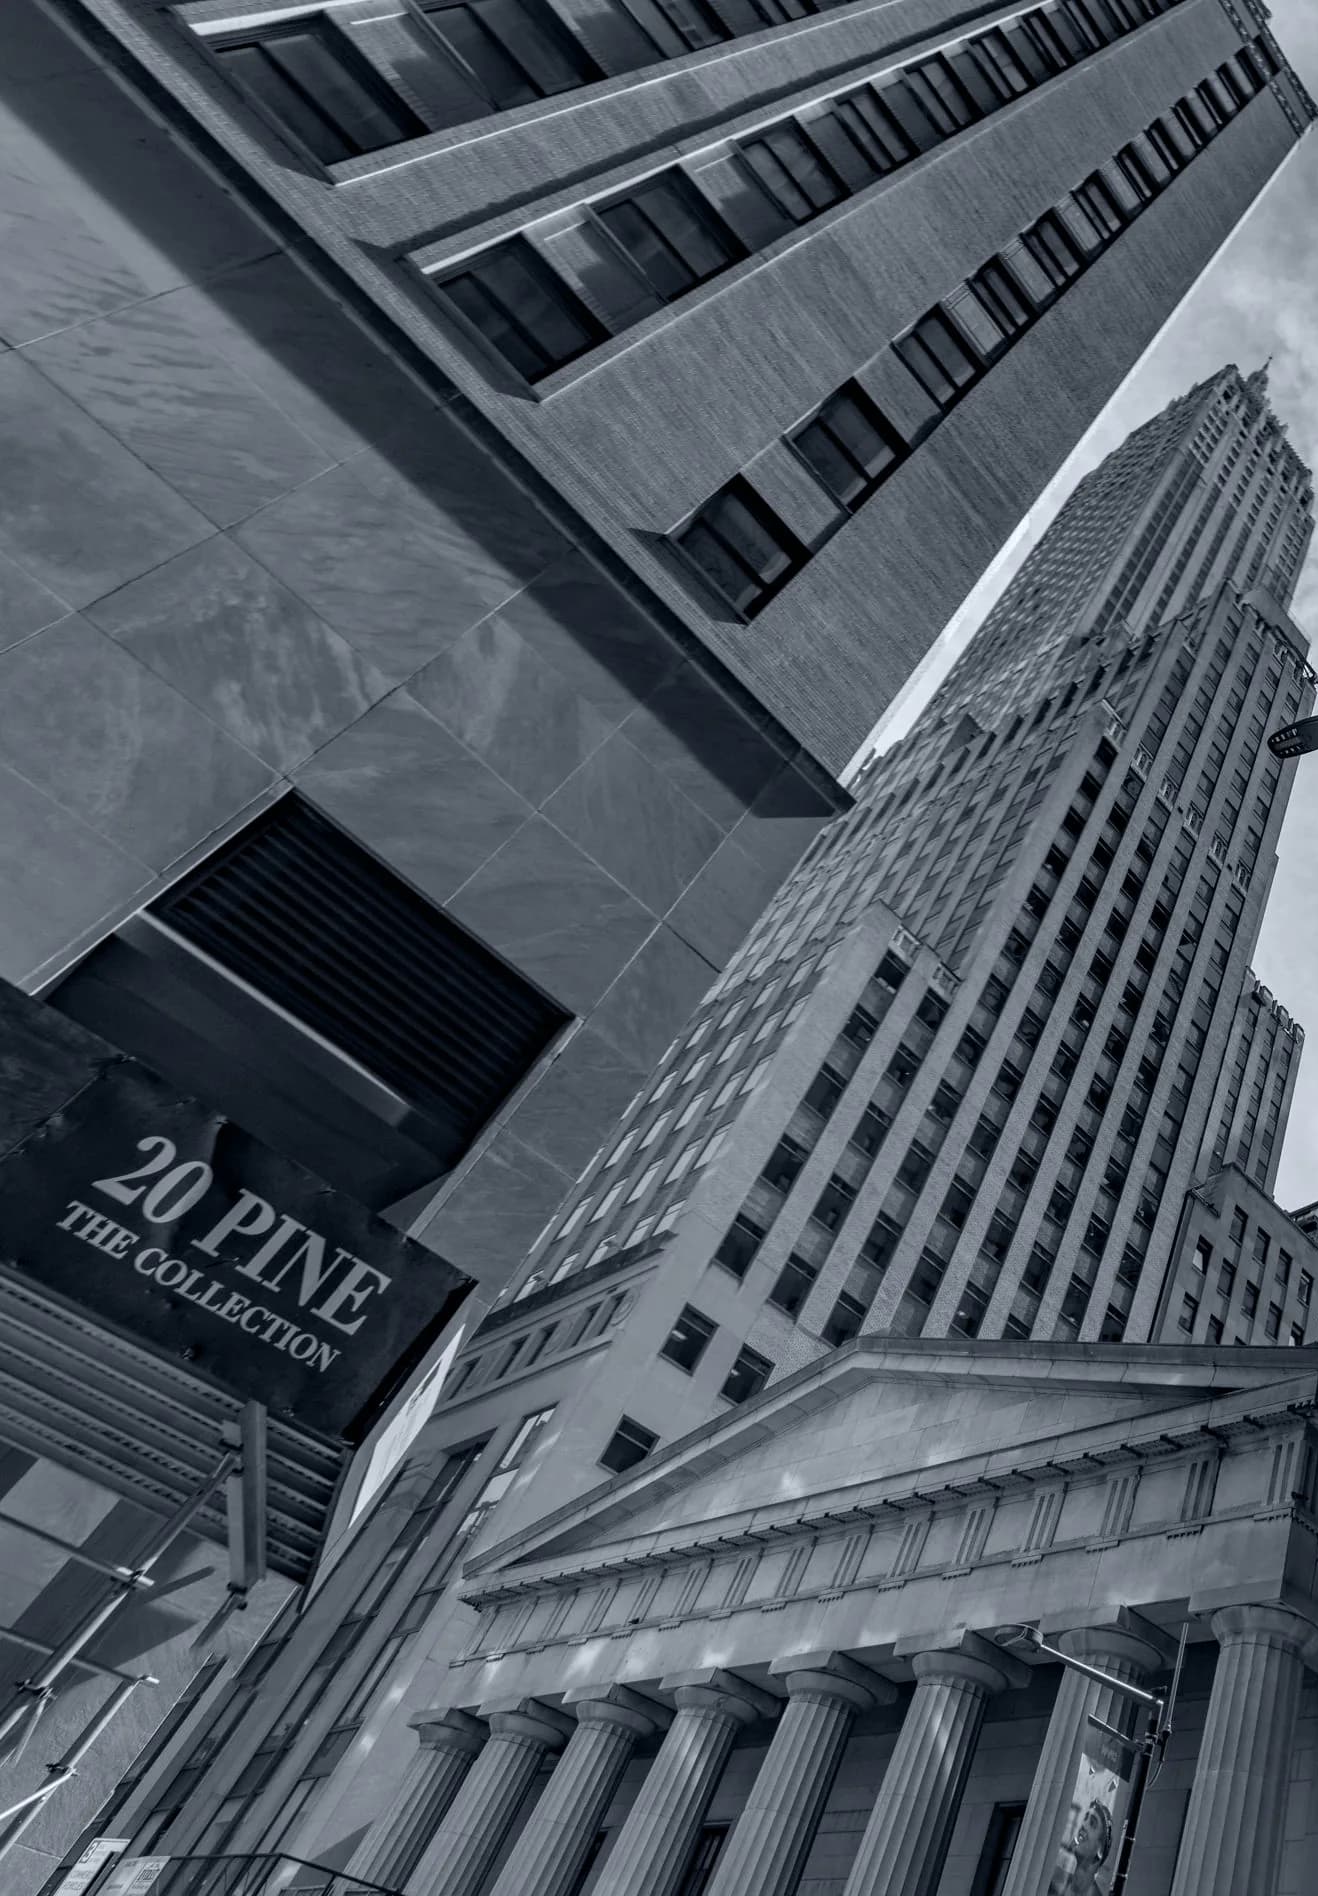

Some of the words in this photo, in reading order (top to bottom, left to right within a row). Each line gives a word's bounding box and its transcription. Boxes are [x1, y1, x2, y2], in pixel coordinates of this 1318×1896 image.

[56, 1201, 140, 1259] THE
[134, 1247, 342, 1373] COLLECTION
[91, 1136, 213, 1224] 20
[190, 1188, 392, 1336] PINE
